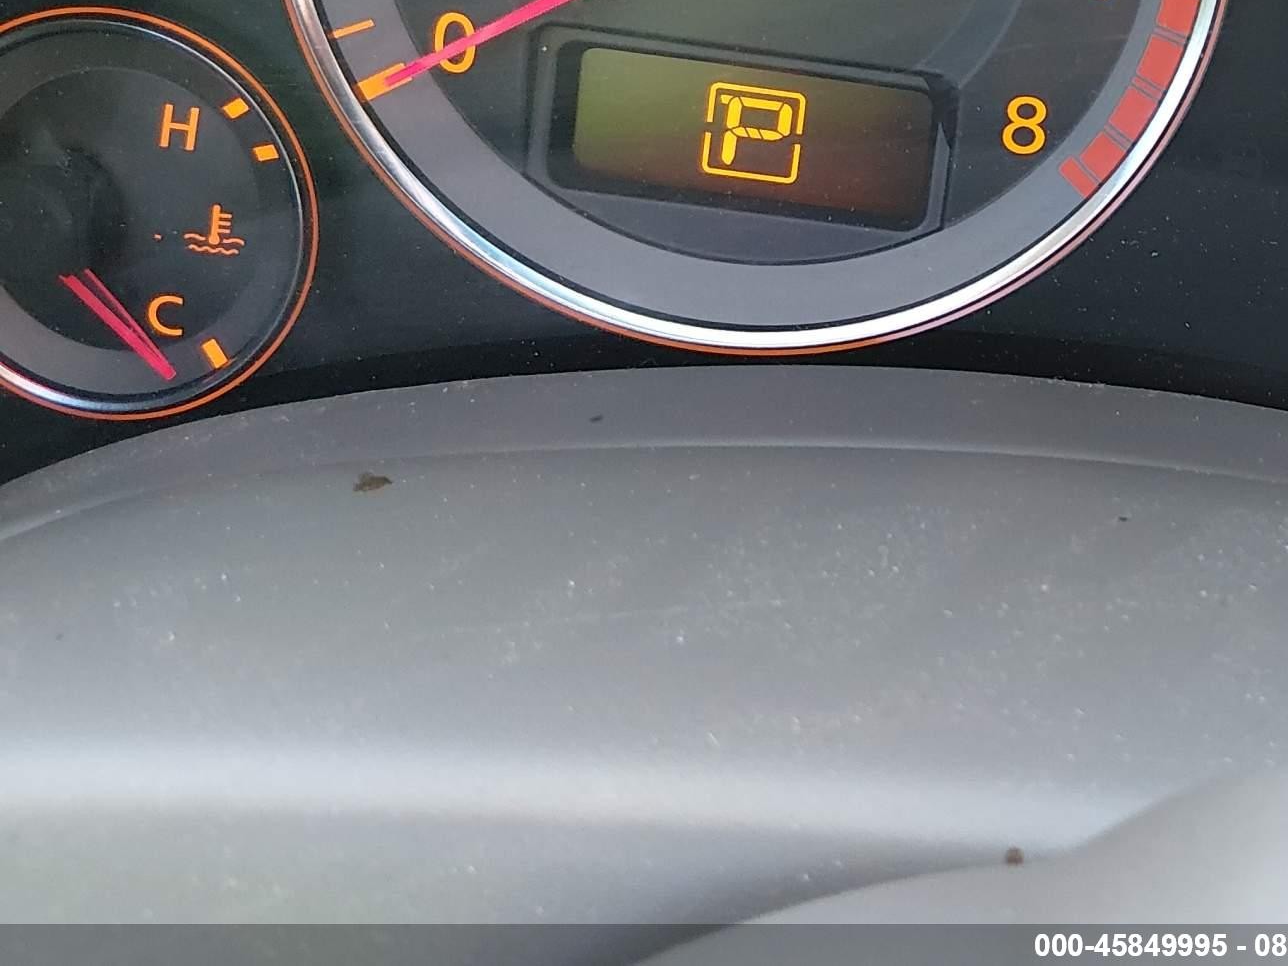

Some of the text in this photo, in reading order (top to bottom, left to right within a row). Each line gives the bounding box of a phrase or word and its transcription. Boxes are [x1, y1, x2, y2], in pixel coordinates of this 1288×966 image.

[434, 12, 476, 73] 0
[159, 103, 200, 151] H
[719, 94, 795, 166] P
[1001, 96, 1049, 156] 8
[147, 294, 184, 336] C
